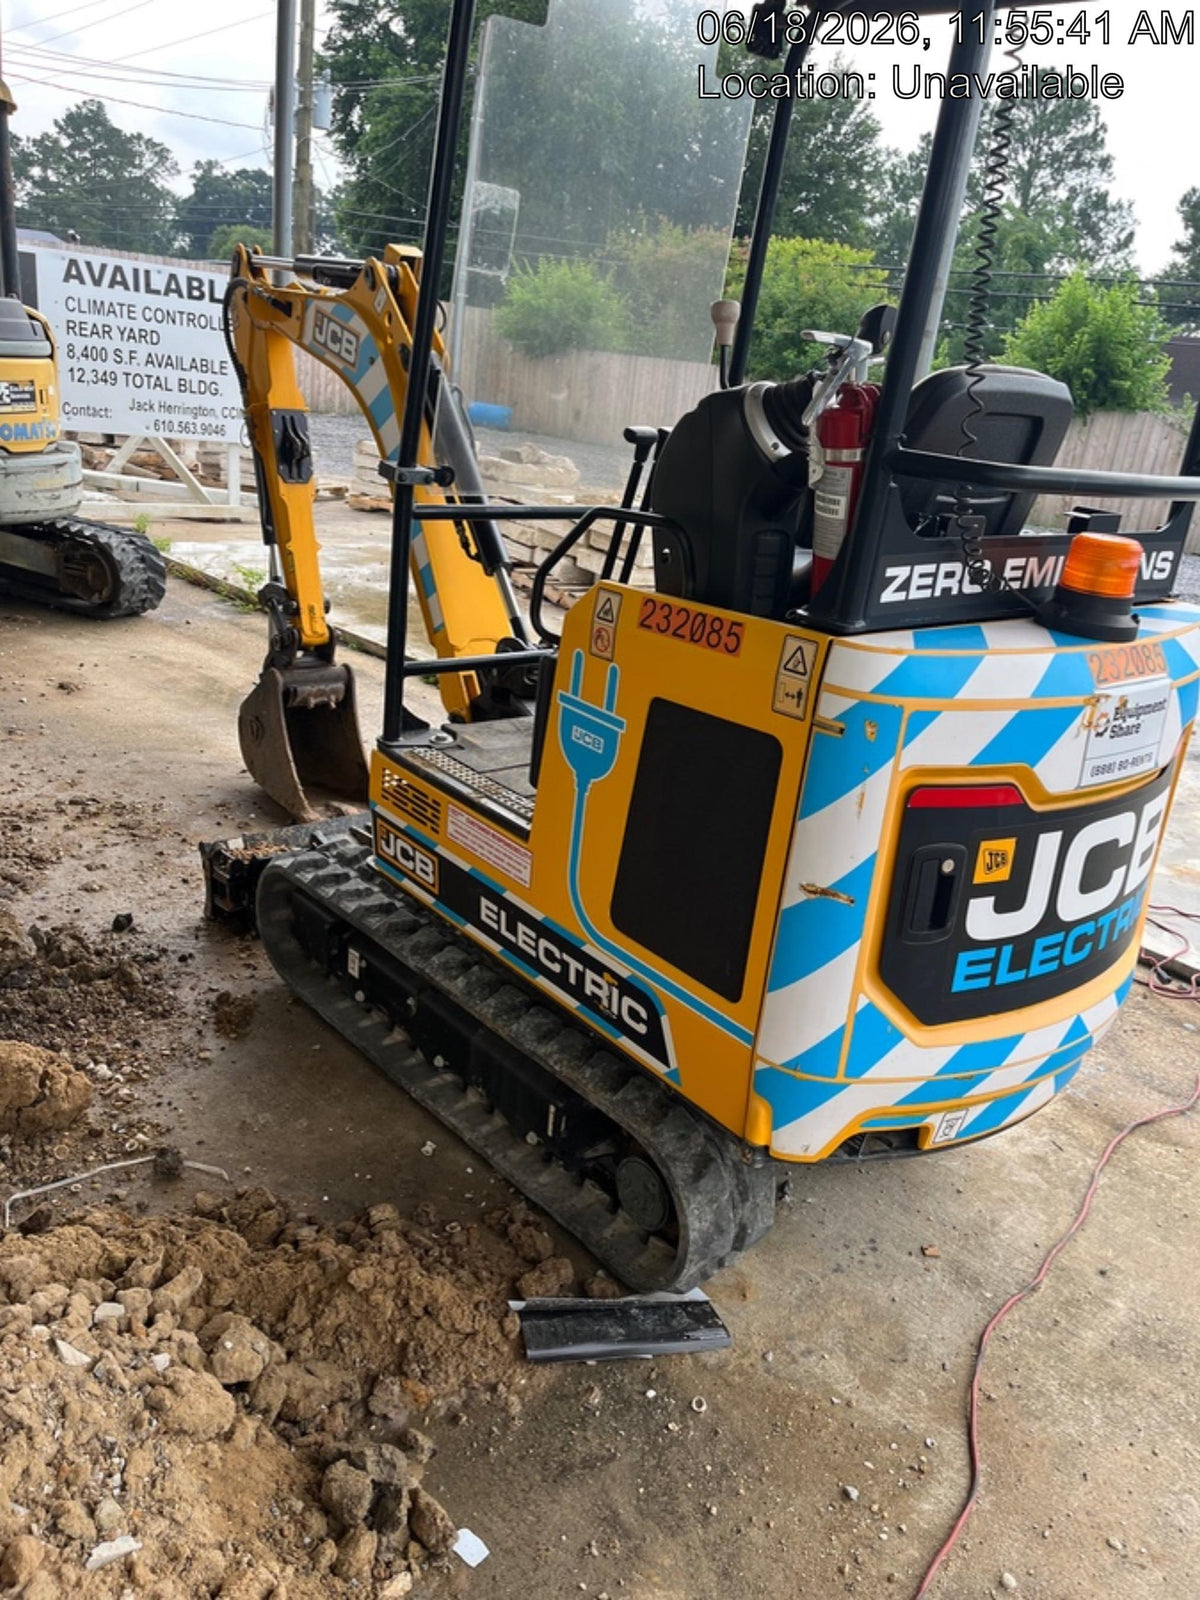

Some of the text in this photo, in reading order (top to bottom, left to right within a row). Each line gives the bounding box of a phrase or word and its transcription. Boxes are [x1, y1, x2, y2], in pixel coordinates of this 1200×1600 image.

[62, 257, 225, 304] AVAILABL
[65, 296, 226, 332] CLIMATE CONTROLL
[66, 319, 161, 346] REAR YARD
[314, 315, 359, 369] JCB
[66, 343, 229, 376] 8,400 S.F. AVAILABLE
[68, 366, 223, 397] 12,349 TOTAL BLDG.
[62, 401, 113, 419] Contact:
[129, 398, 155, 413] Jack
[153, 419, 226, 437] 610.563.9046
[880, 550, 1175, 603] ZERO EMINS
[639, 598, 744, 654] 232085
[1089, 643, 1167, 683] 232085
[573, 728, 602, 751] JCB
[1109, 722, 1142, 740] Share
[381, 832, 435, 884] JCB
[985, 850, 1007, 872] JCB
[951, 882, 1146, 992] ELECTR
[480, 896, 648, 1035] ELECTRIC
